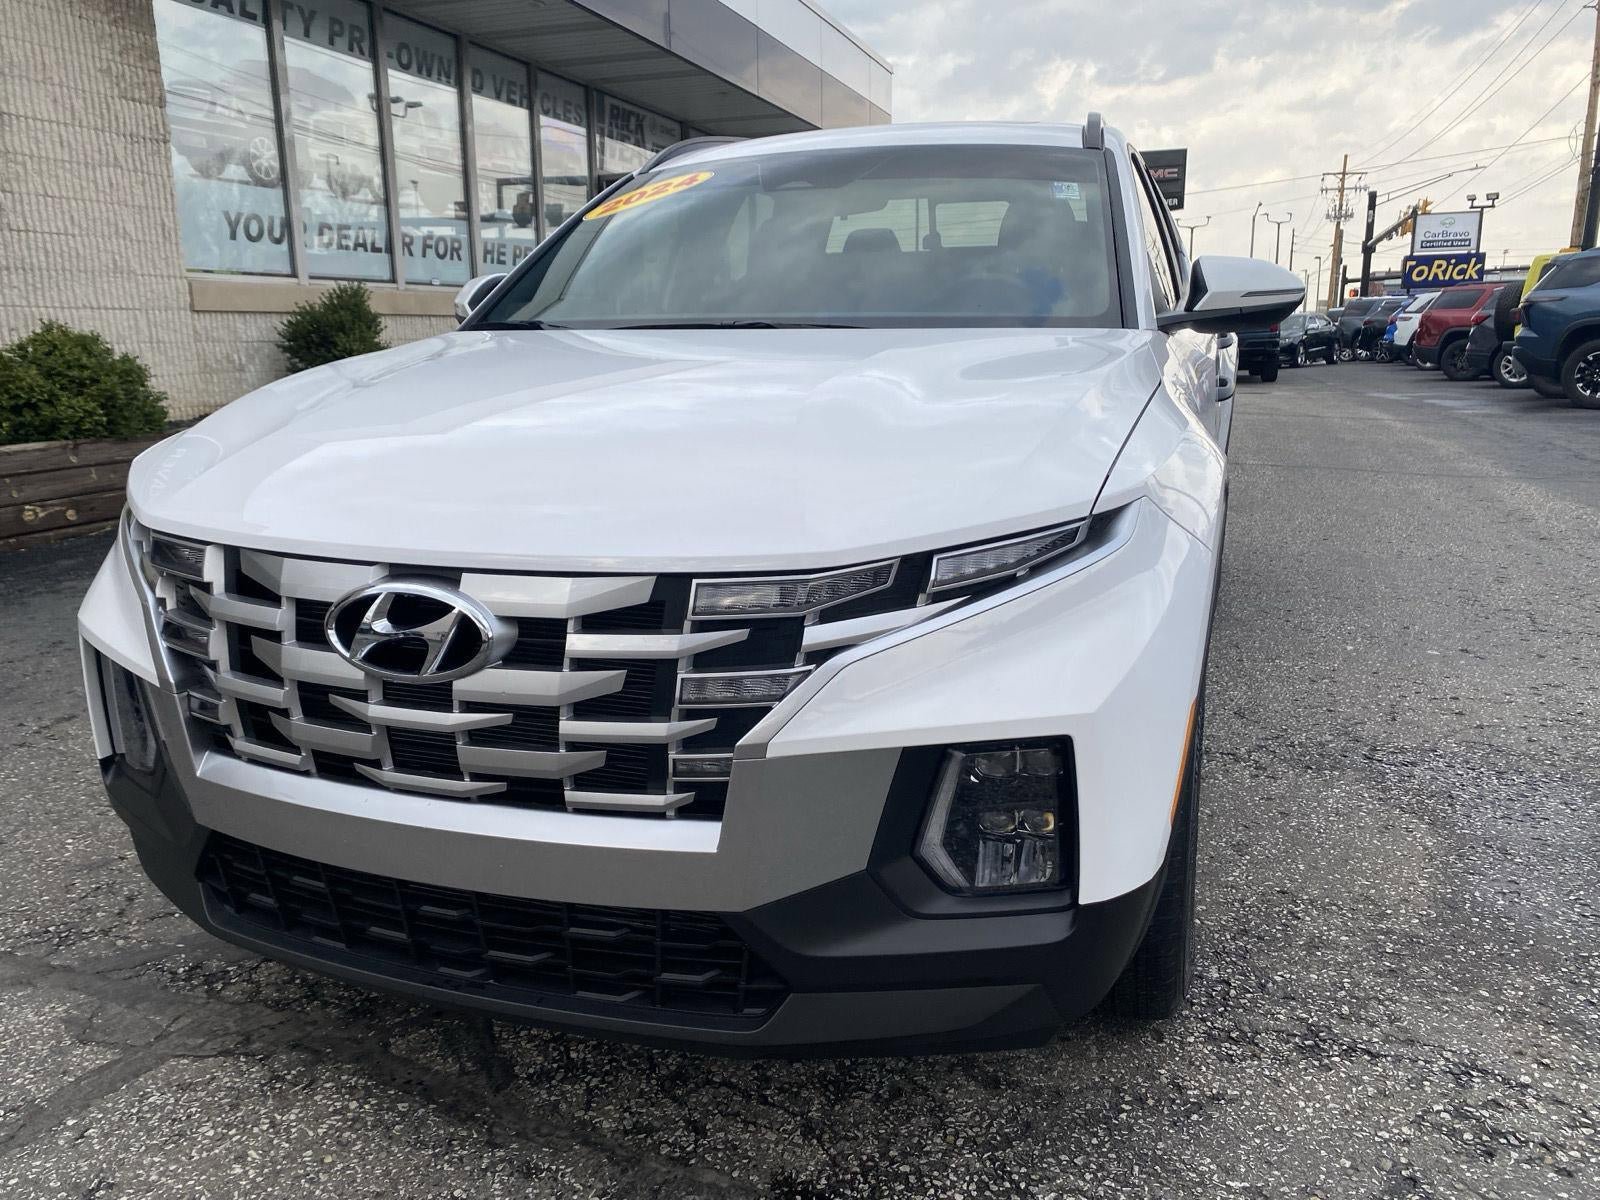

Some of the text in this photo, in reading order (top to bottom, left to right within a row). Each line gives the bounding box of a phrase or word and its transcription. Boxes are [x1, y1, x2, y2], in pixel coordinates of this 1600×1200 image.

[1149, 168, 1178, 178] MC
[597, 172, 700, 216] 2024
[1423, 230, 1470, 239] CarBravo
[421, 233, 462, 262] FOR
